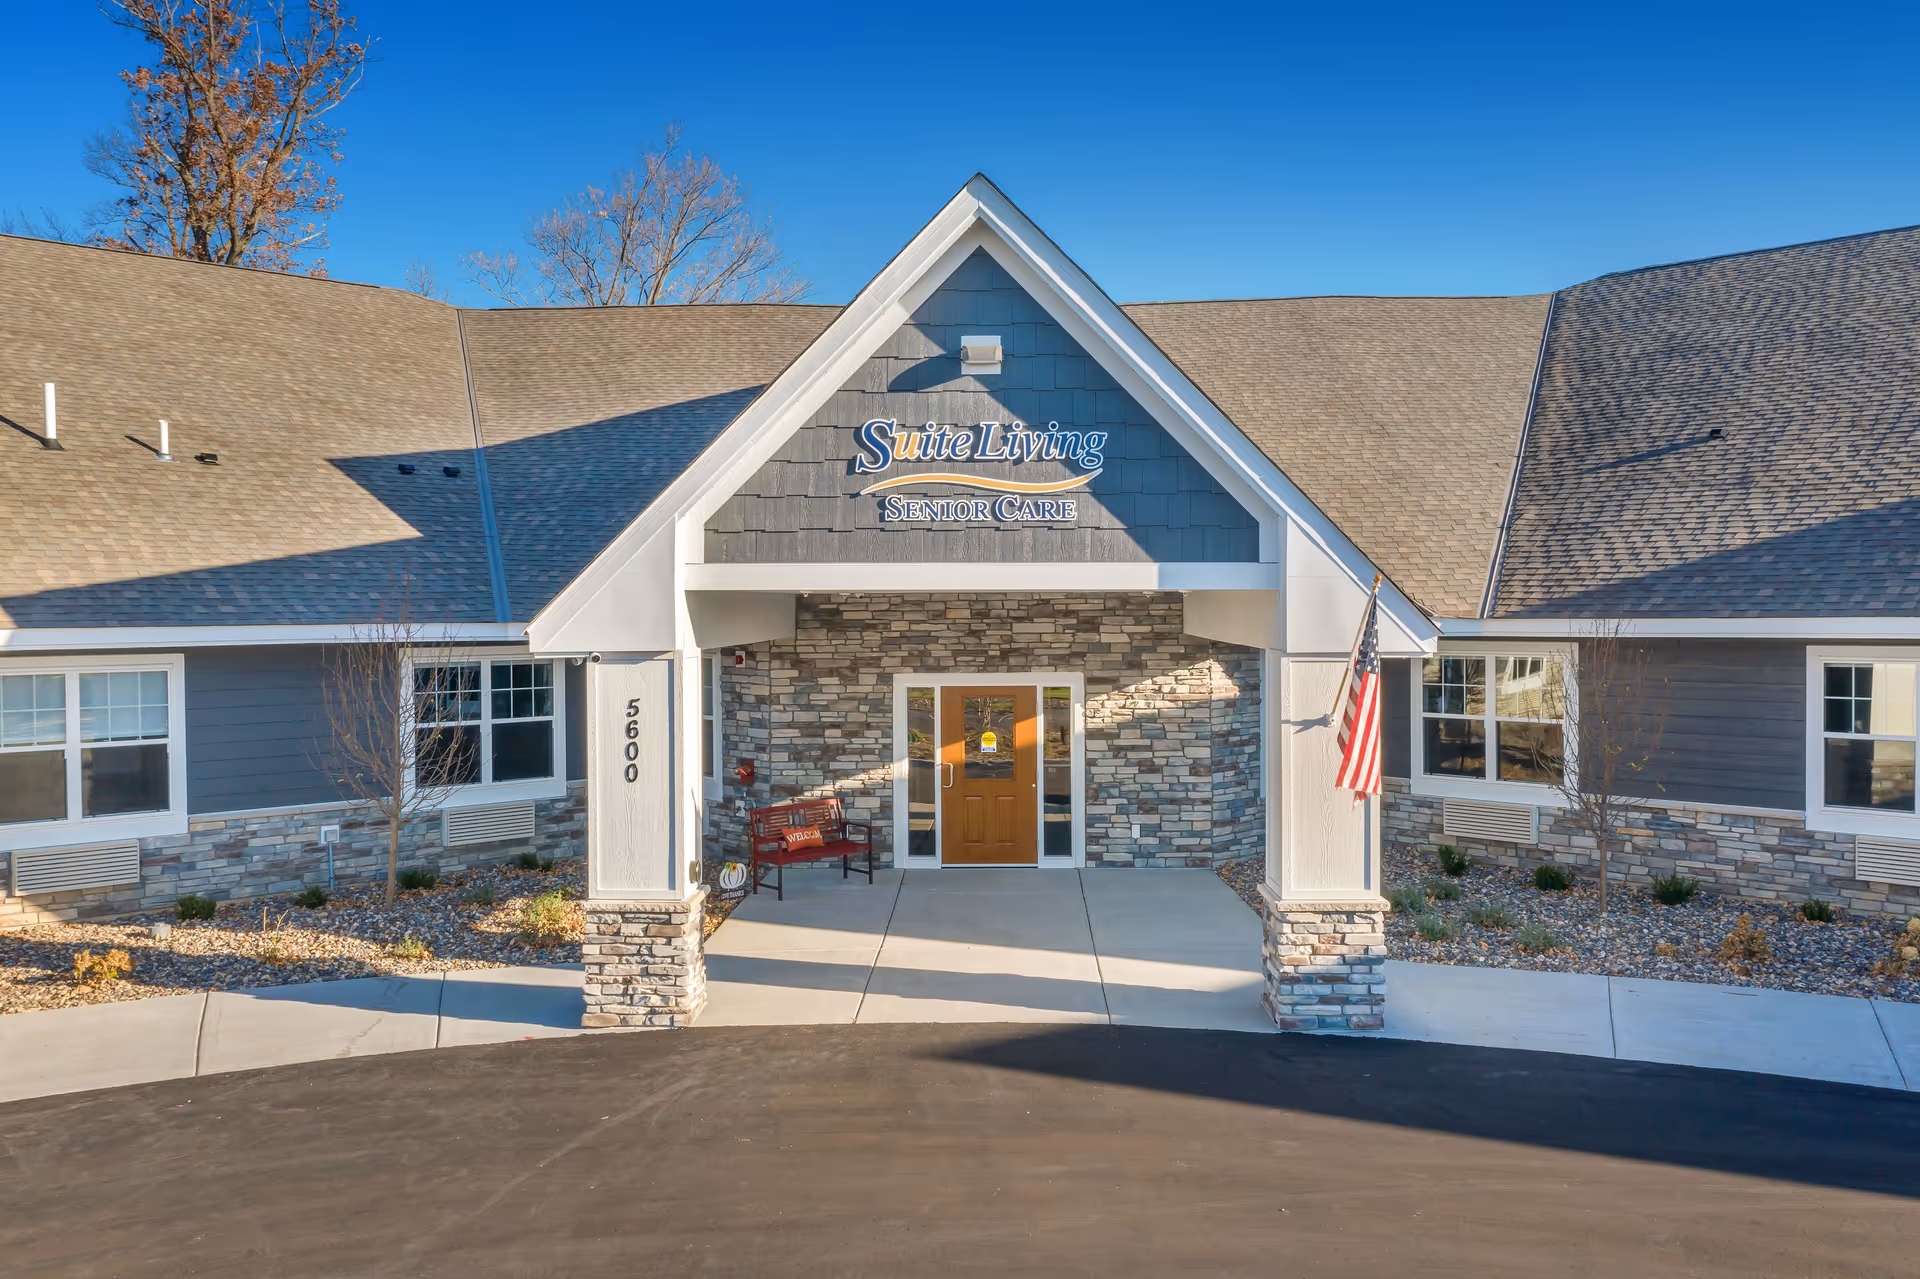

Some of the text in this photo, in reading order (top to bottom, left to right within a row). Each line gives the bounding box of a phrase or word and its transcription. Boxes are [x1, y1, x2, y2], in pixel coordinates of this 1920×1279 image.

[856, 419, 1108, 473] Suite Living
[885, 495, 1077, 521] SENIOR CARE
[624, 698, 640, 783] 5600
[786, 830, 822, 843] WELCOM
